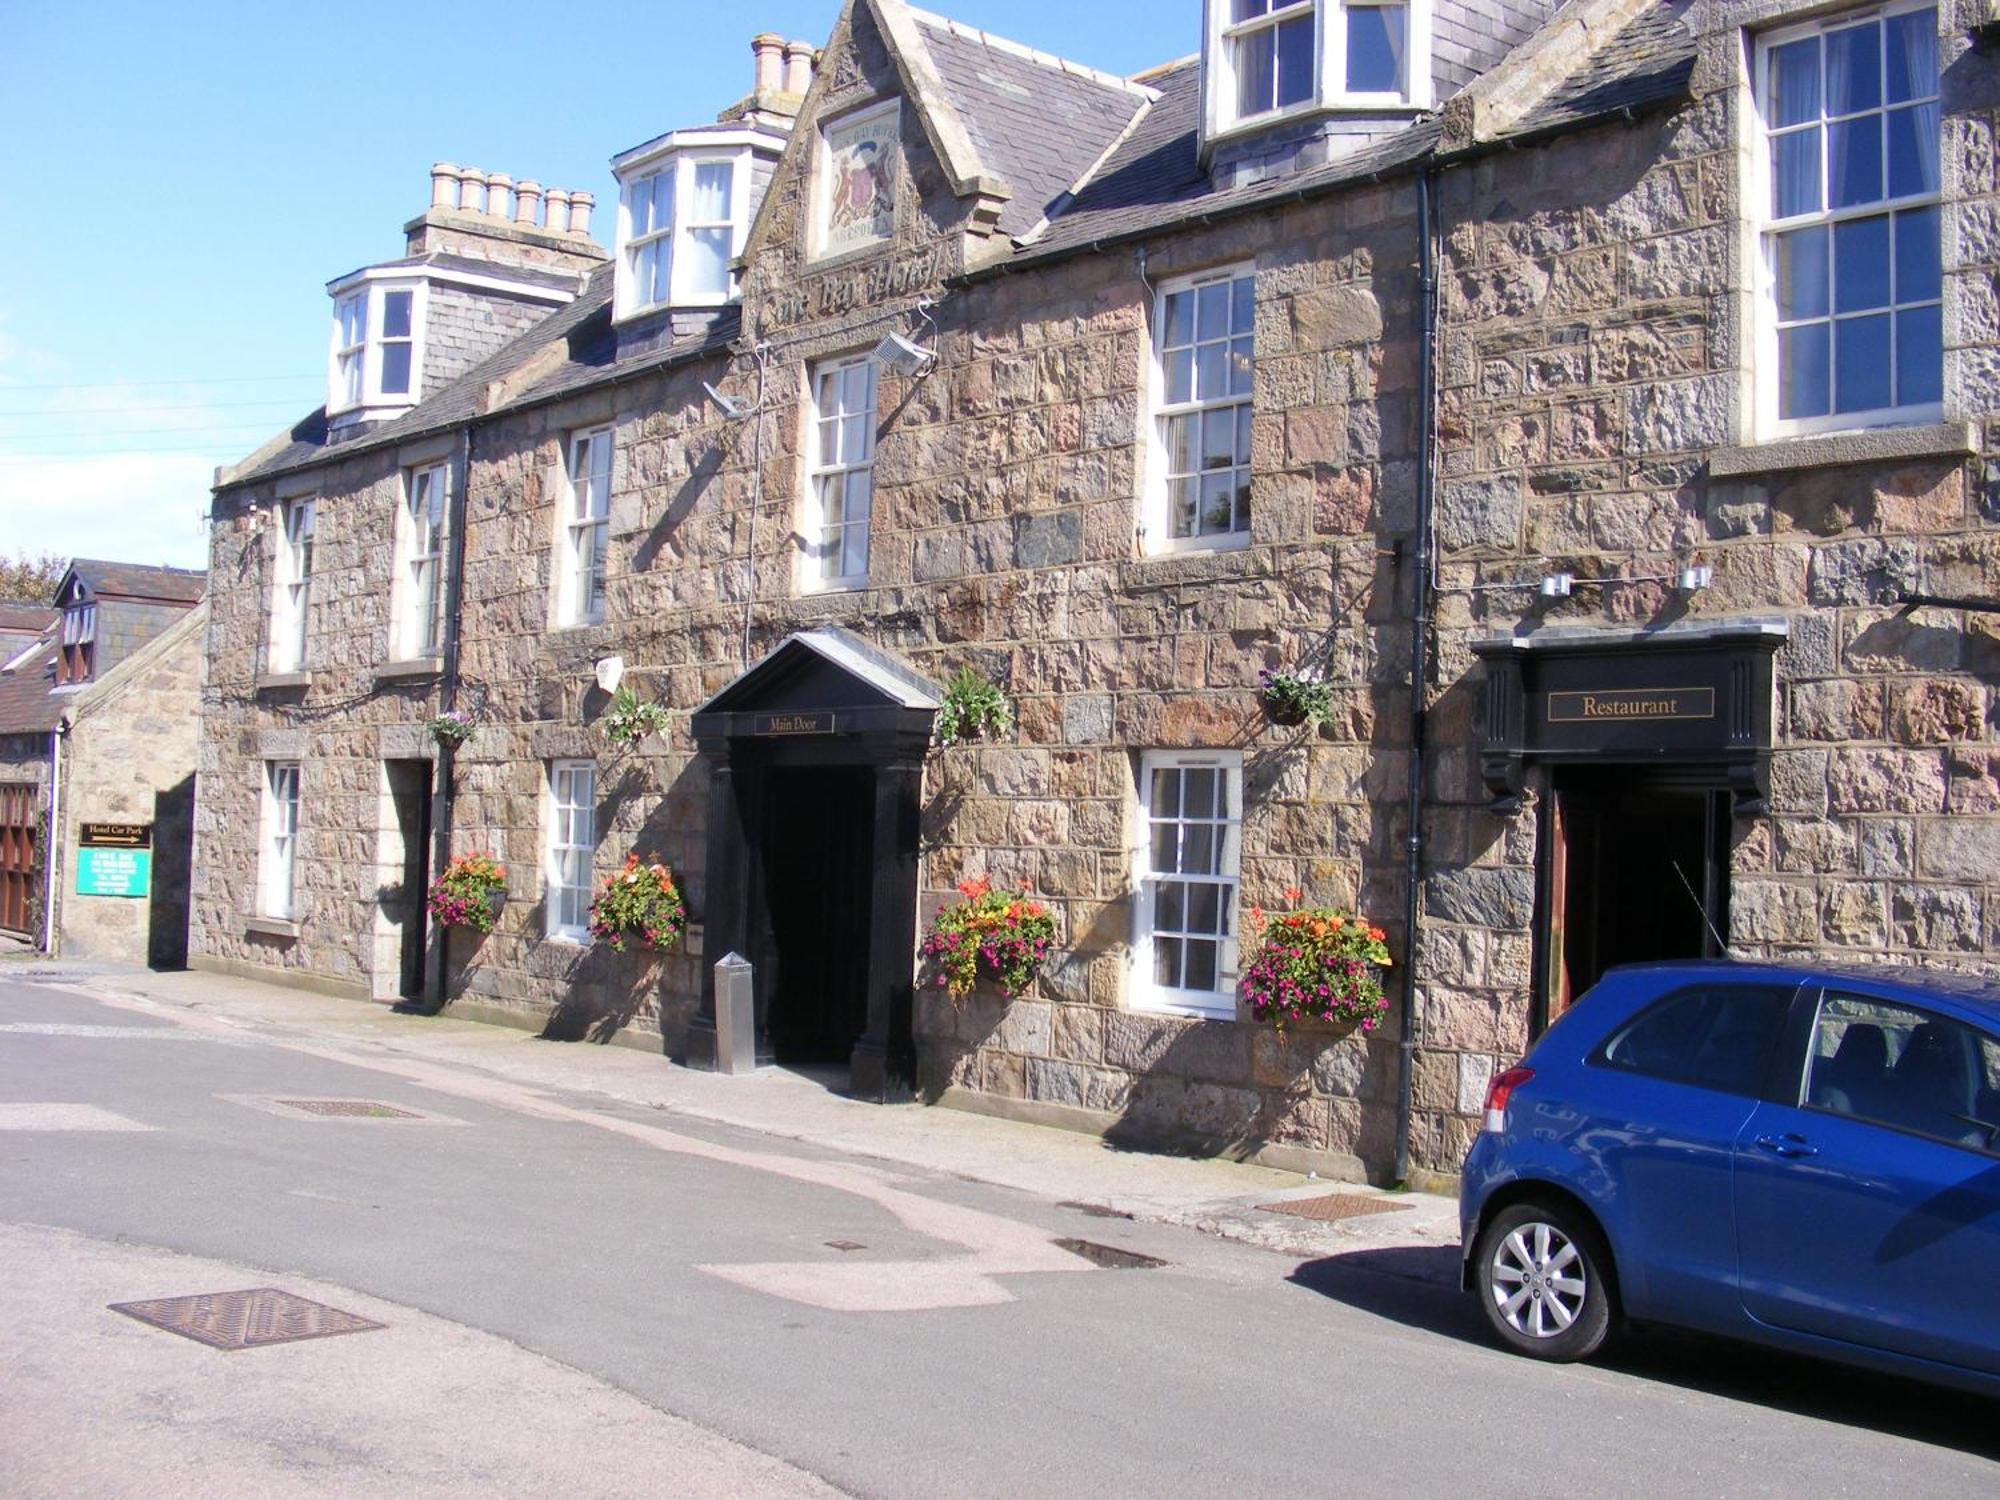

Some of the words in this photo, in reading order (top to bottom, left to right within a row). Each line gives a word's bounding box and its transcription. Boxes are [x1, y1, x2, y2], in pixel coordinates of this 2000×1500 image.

[1583, 696, 1678, 716] Restaurant
[769, 717, 793, 732] Main
[794, 716, 817, 731] Door
[89, 823, 110, 833] Hotel
[111, 825, 126, 834] Car
[126, 825, 143, 835] Park
